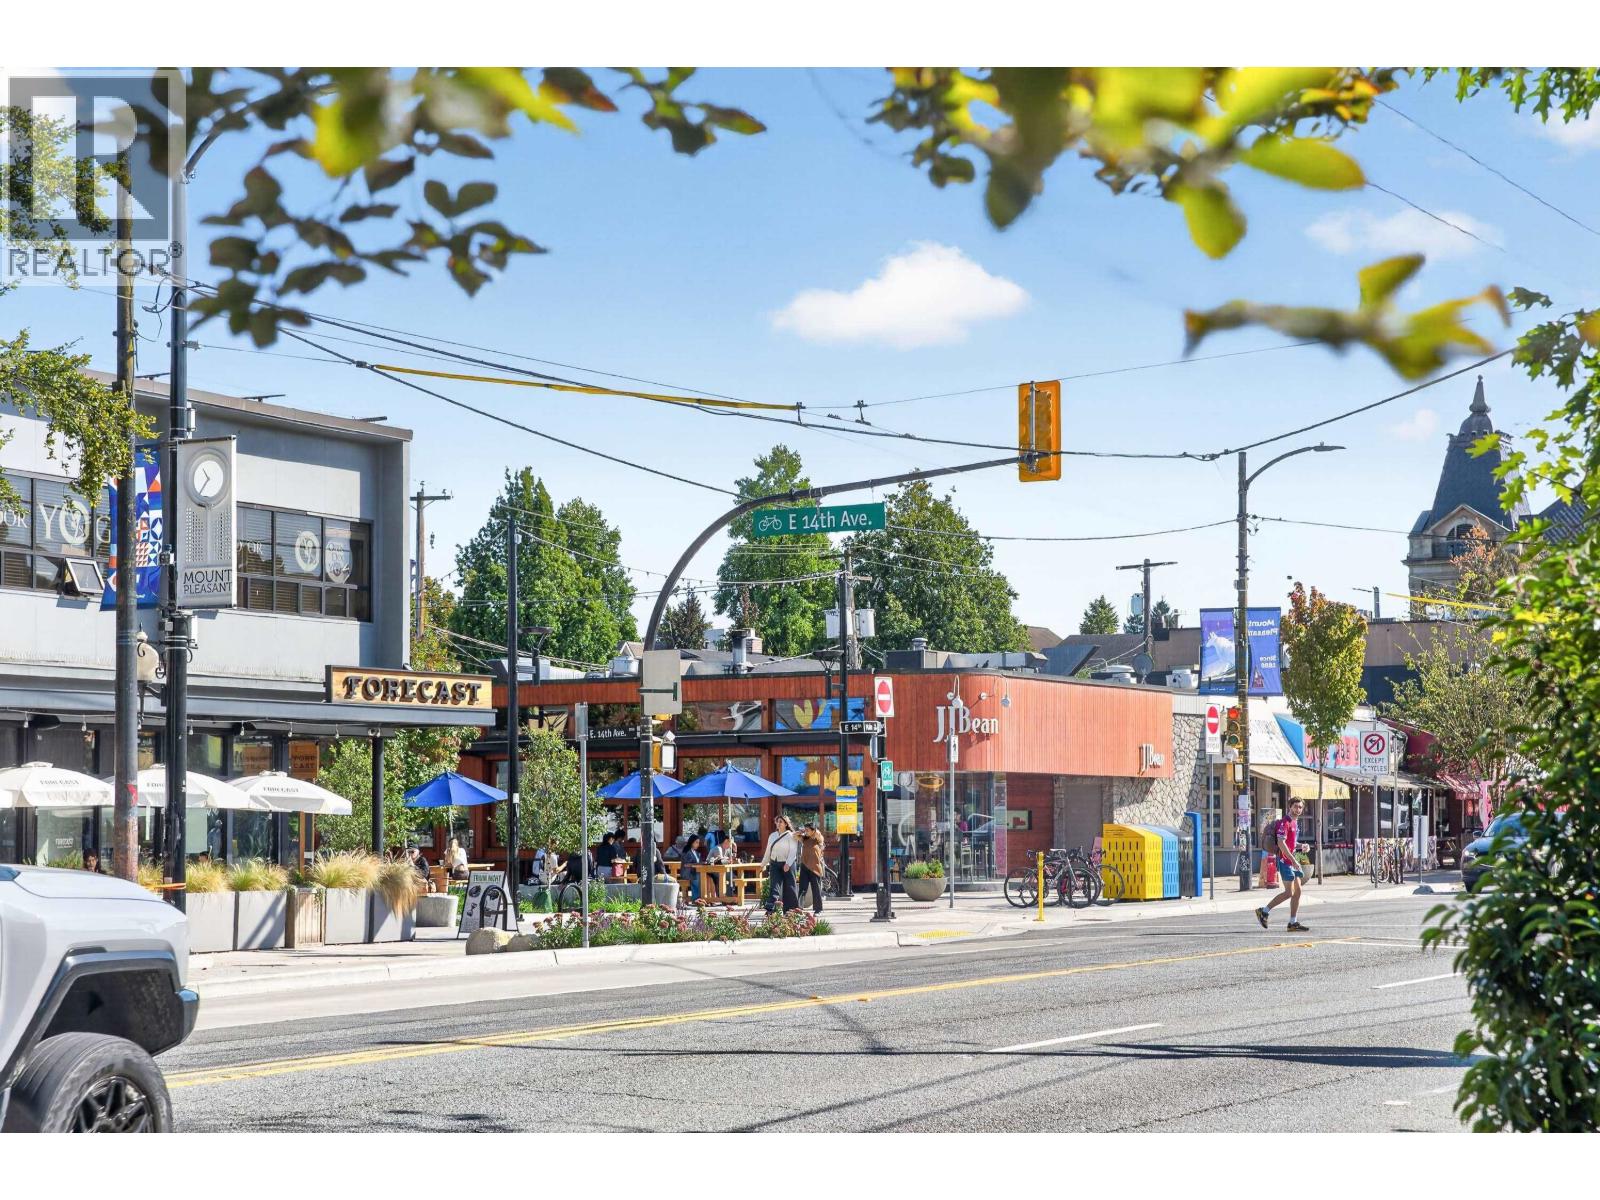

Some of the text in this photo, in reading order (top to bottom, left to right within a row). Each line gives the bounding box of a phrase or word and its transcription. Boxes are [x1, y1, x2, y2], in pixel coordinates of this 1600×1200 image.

[789, 510, 873, 531] E 14th Ave.
[183, 569, 232, 585] MOUNT
[183, 582, 232, 595] PLEASANT
[343, 675, 482, 705] FORECAST
[589, 729, 596, 739] E.
[597, 728, 612, 739] 14th
[613, 728, 627, 738] Ave.
[844, 724, 849, 732] E
